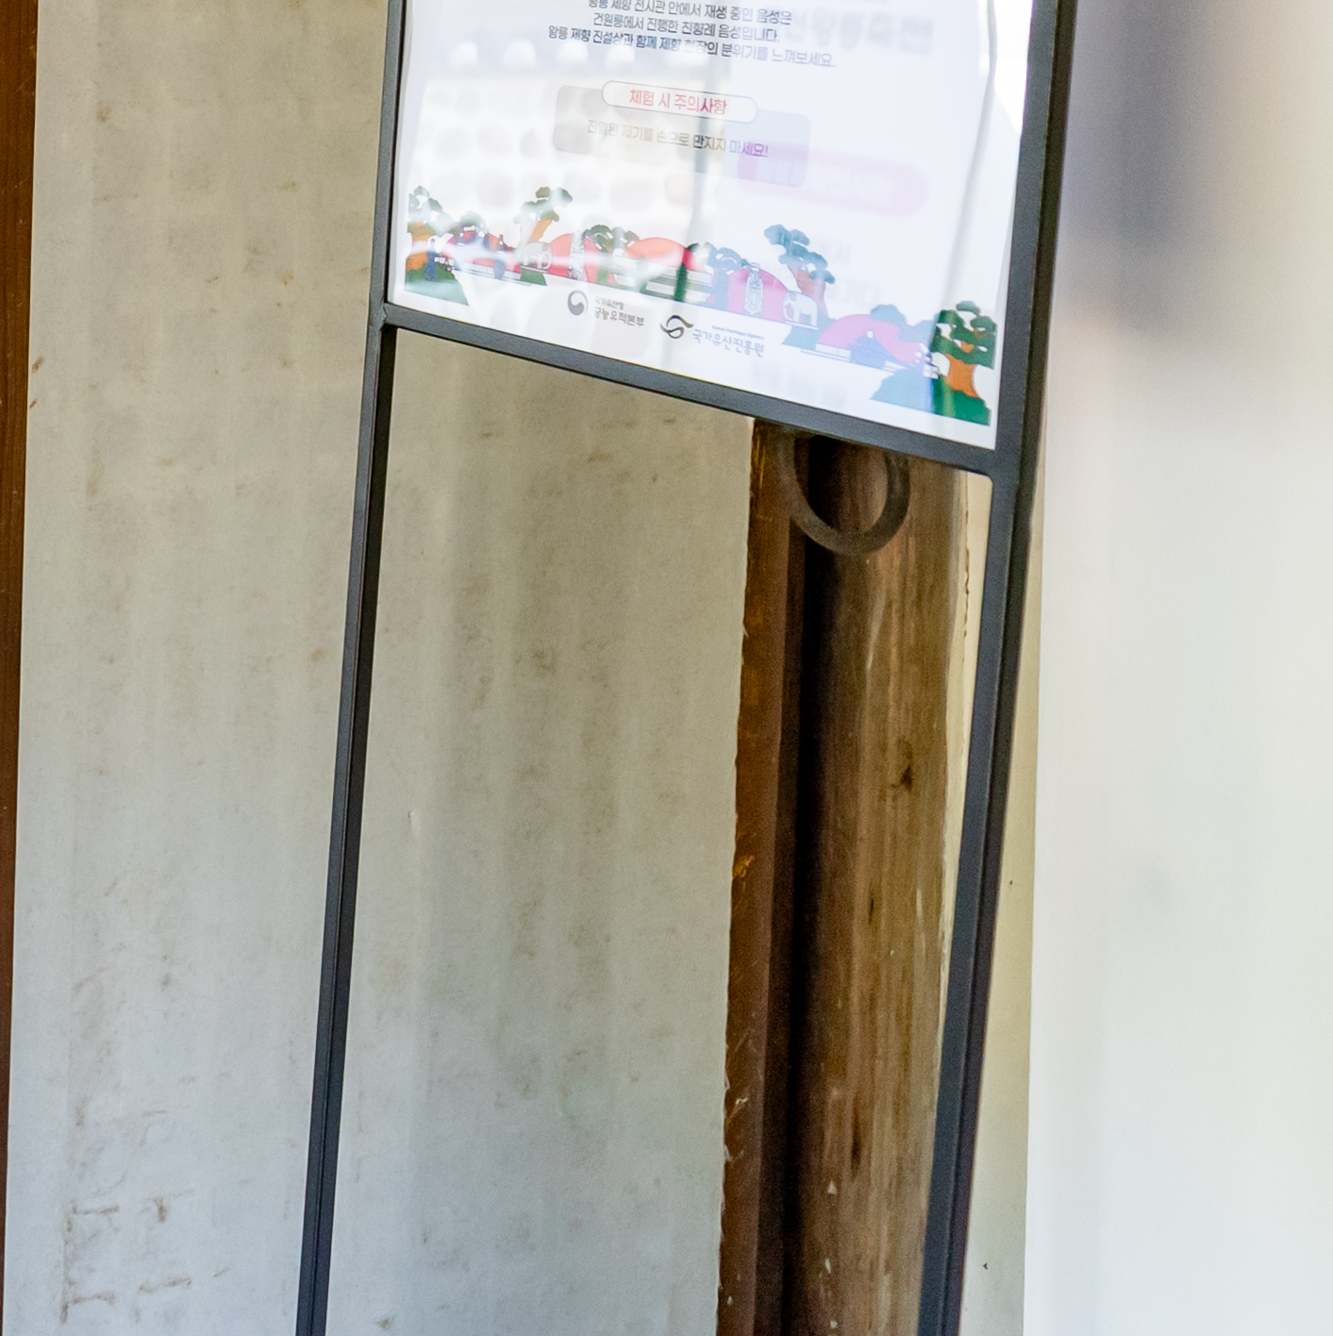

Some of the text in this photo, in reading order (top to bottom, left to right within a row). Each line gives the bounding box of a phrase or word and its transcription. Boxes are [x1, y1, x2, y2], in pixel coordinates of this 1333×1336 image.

[593, 12, 644, 30] 건원릉에서
[646, 17, 679, 34] 진행한
[718, 23, 780, 43] 음성입니다.
[668, 1, 701, 18] 안에서
[704, 4, 728, 20] 재생
[730, 5, 753, 22] 중인
[757, 7, 792, 26] 음성은
[548, 25, 569, 40] 왕릉
[570, 27, 591, 43] 제향
[635, 34, 657, 50] 함께
[659, 36, 682, 52] 제향
[721, 42, 769, 61] 분위기를
[629, 88, 728, 115] 체험 시 주의사항
[656, 129, 690, 147] 손으로
[692, 134, 726, 152] 만지지
[729, 139, 769, 158] 마세요!
